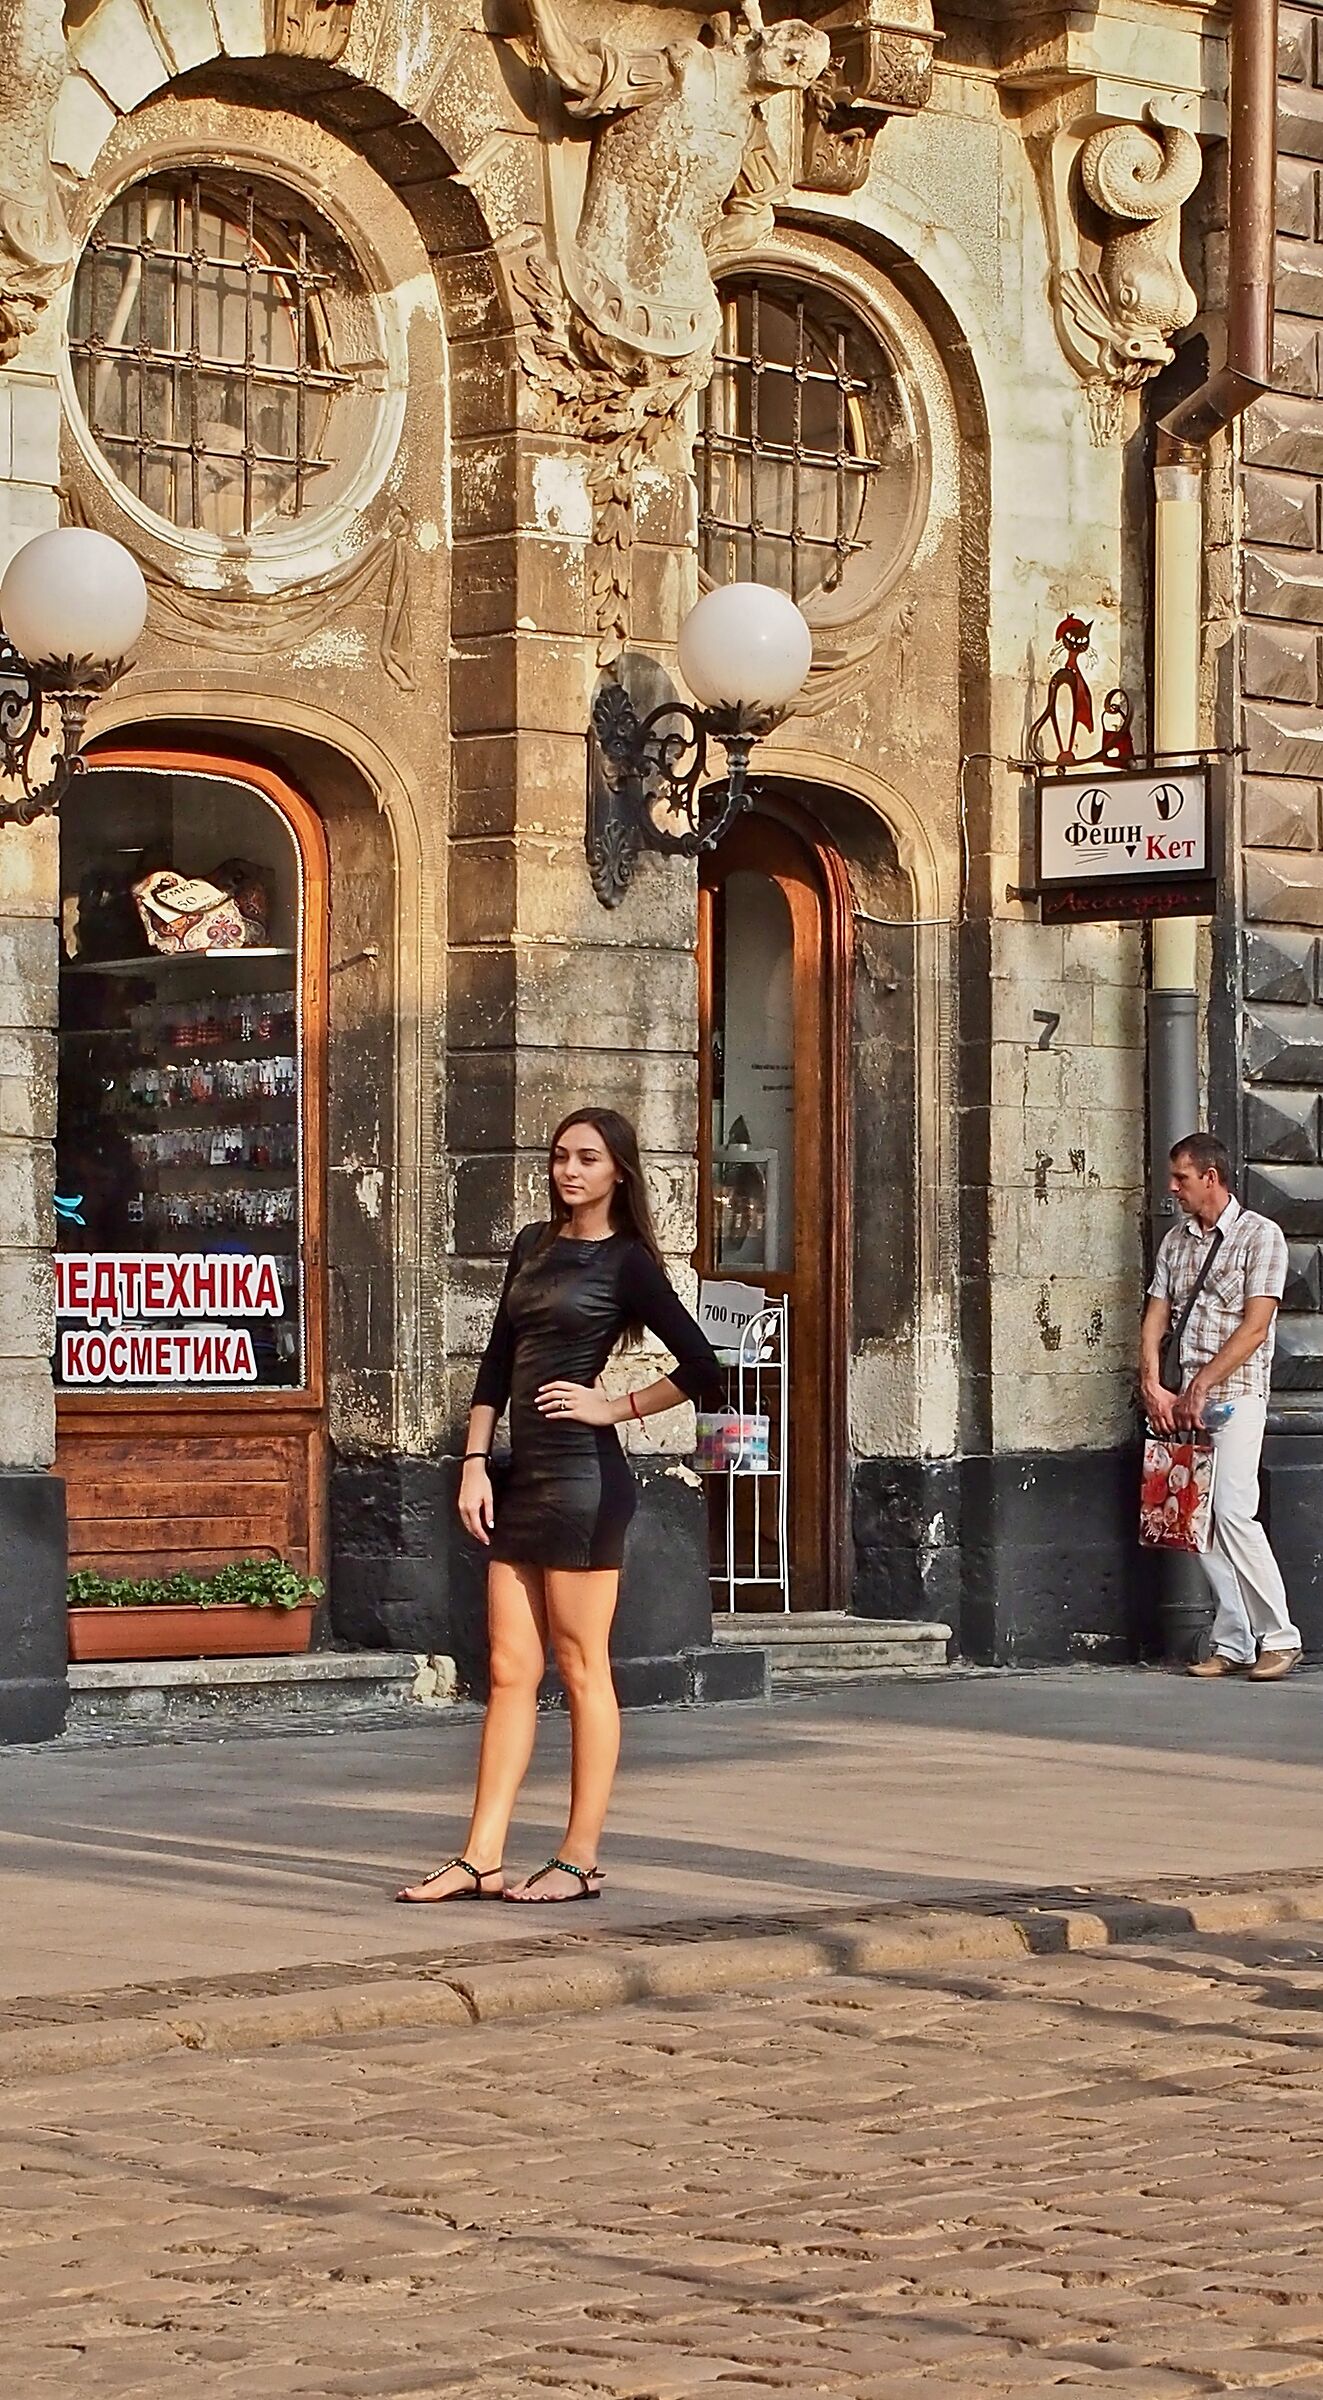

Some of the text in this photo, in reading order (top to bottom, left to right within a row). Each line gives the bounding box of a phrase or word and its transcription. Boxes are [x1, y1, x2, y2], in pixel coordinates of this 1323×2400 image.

[1064, 821, 1143, 847] Фешн
[1145, 834, 1196, 861] Кет
[160, 881, 199, 900] УМКА
[1033, 1009, 1060, 1050] 7
[704, 1304, 728, 1323] 700
[67, 1336, 252, 1376] КОСМЕТИКА
